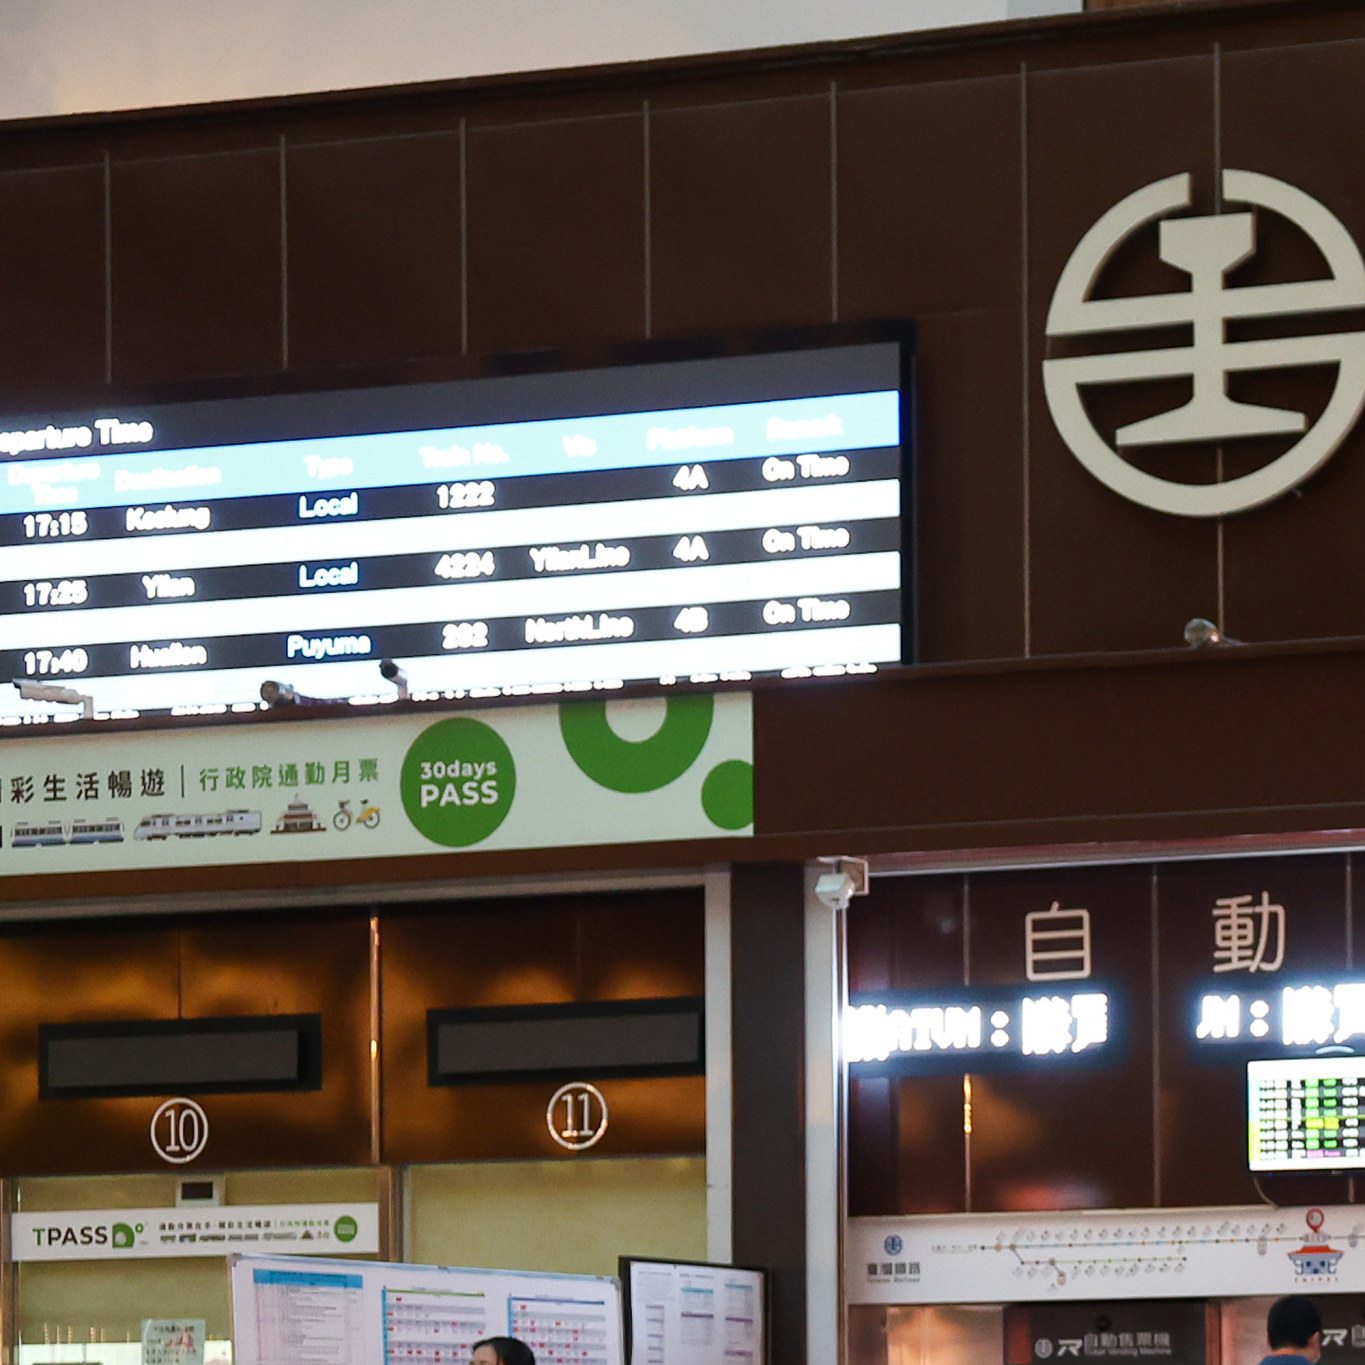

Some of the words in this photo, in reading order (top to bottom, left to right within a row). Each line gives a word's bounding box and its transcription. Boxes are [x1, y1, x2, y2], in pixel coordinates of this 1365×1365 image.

[23, 511, 88, 538] 17:15
[299, 492, 359, 518] Local
[762, 456, 796, 482] On
[797, 455, 850, 479] Time
[299, 561, 359, 588] Local
[762, 528, 796, 553] On
[797, 526, 850, 550] Time
[287, 634, 371, 658] Puyuma
[762, 599, 796, 625] On
[797, 597, 850, 621] Time
[0, 768, 166, 804] 彩生活暢遊
[199, 757, 380, 792] 行政院通勤月票
[420, 759, 497, 780] 30days
[420, 780, 499, 807] PASS
[164, 1108, 198, 1153] 10
[561, 1092, 594, 1137] 11
[33, 1226, 108, 1247] TPASS
